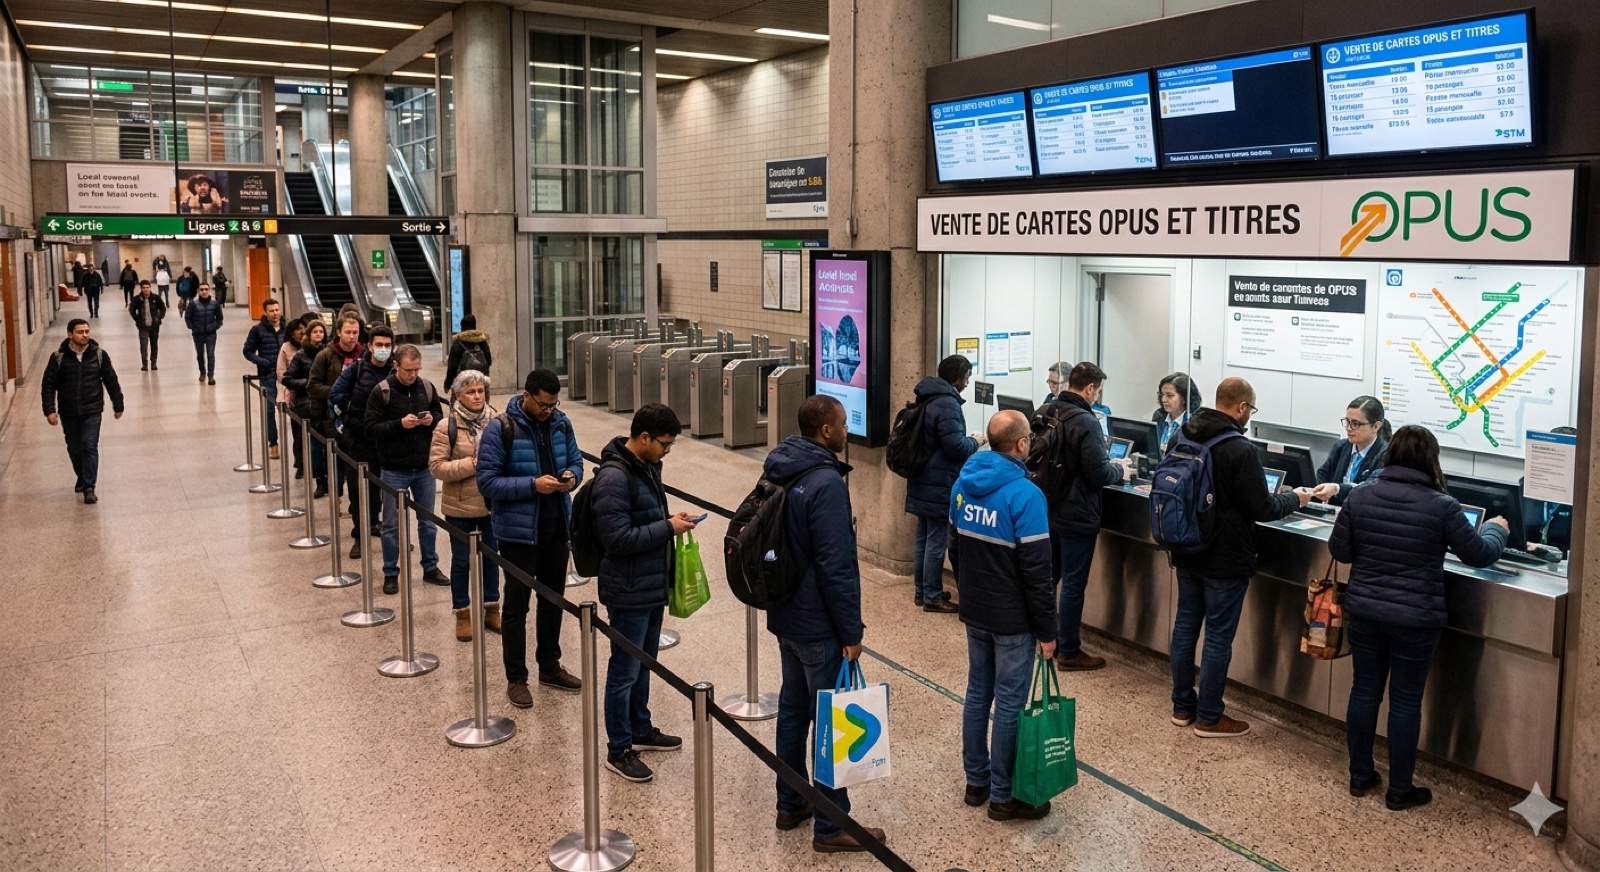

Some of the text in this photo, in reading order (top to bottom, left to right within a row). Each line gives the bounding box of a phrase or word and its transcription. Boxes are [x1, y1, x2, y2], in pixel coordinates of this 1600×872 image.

[1373, 41, 1384, 52] DE
[1386, 36, 1420, 50] CARTES
[1423, 32, 1448, 44] OPUS
[1451, 30, 1462, 40] ET
[1465, 24, 1500, 38] TITRES
[1504, 128, 1525, 138] STM
[930, 204, 1301, 236] VENTE DE CARTES OPUS ET TITRES
[1352, 187, 1531, 242] OPUS
[66, 220, 103, 231] Sortie
[188, 220, 226, 234] Lignes
[242, 220, 250, 231] &
[402, 222, 432, 232] Sortie
[1260, 282, 1270, 292] de
[1314, 284, 1326, 294] de
[1328, 284, 1358, 296] OPUS
[964, 504, 998, 528] STM
